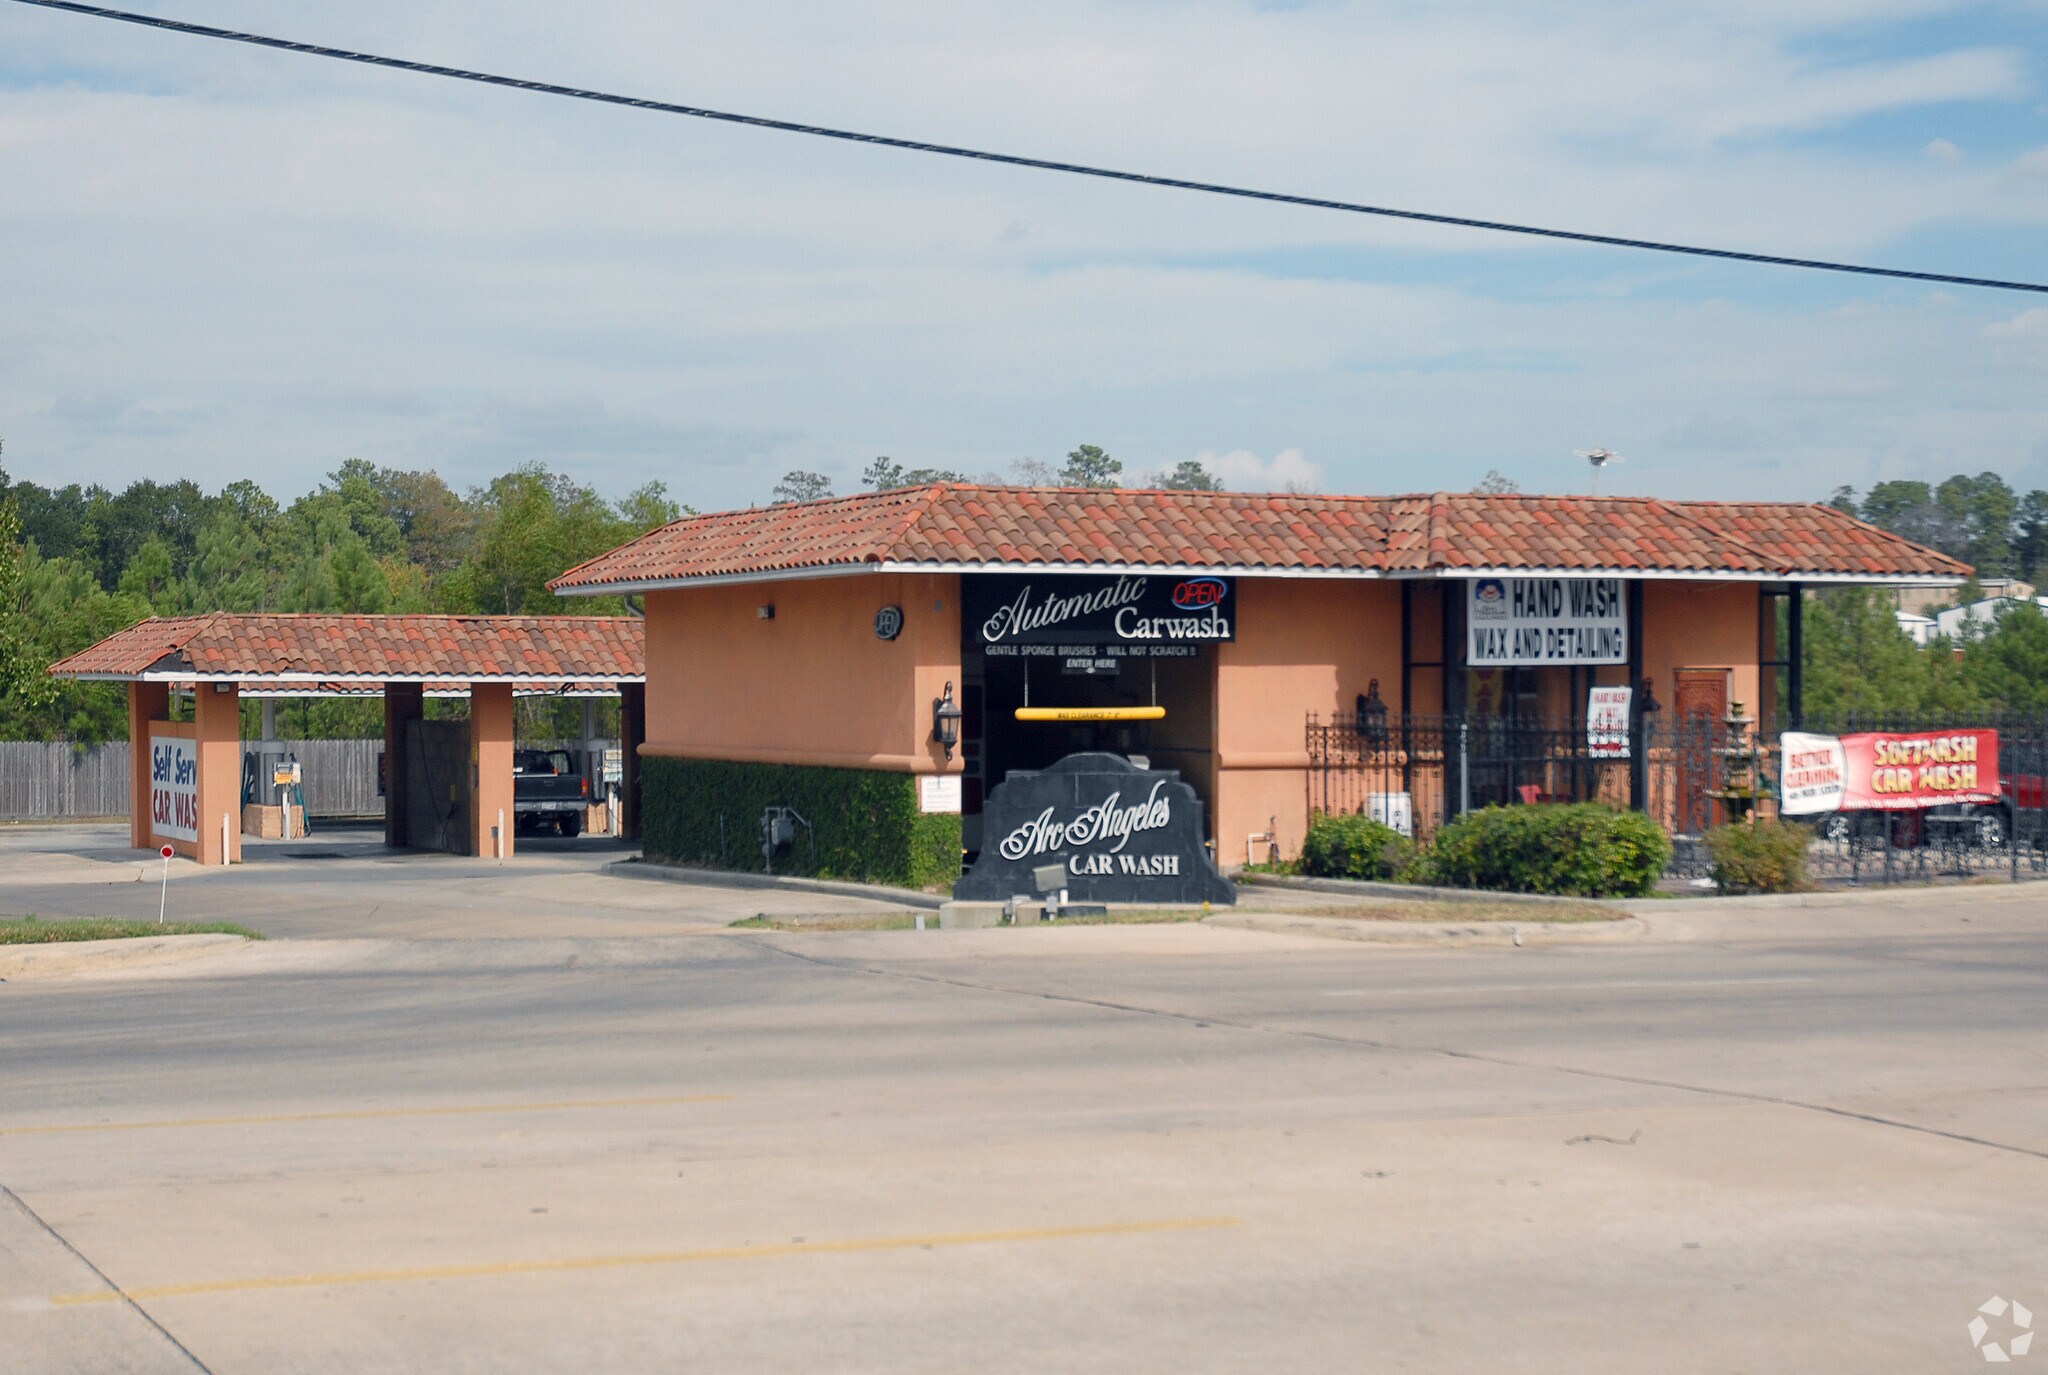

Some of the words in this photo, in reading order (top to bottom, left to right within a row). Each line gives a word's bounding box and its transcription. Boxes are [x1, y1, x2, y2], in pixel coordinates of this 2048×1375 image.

[983, 574, 1148, 642] Automatic
[1173, 582, 1223, 605] OPEN
[1513, 579, 1562, 618] HAND
[1569, 579, 1620, 618] WASH
[1114, 605, 1231, 639] Carwash
[985, 645, 1018, 656] GENTLE
[1021, 645, 1055, 656] SPONGE
[1058, 645, 1097, 656] BRUSHES
[1106, 645, 1127, 656] WILL
[1128, 645, 1147, 656] NOT
[1149, 645, 1188, 656] SCRATCH
[1474, 627, 1508, 659] WAX
[1513, 627, 1543, 659] AND
[1548, 627, 1623, 659] DETAILING
[1065, 658, 1093, 669] ENTER
[1094, 658, 1117, 669] HERE
[153, 745, 172, 782] Self
[1873, 735, 1978, 766] SOFTWASH
[1870, 767, 1913, 794] CAR
[1918, 764, 1978, 791] WASH
[153, 789, 171, 826] CAR
[1000, 806, 1065, 860] Arc
[1065, 779, 1170, 854] Angeles
[1069, 854, 1114, 876] CAR
[1118, 854, 1180, 876] WASH
